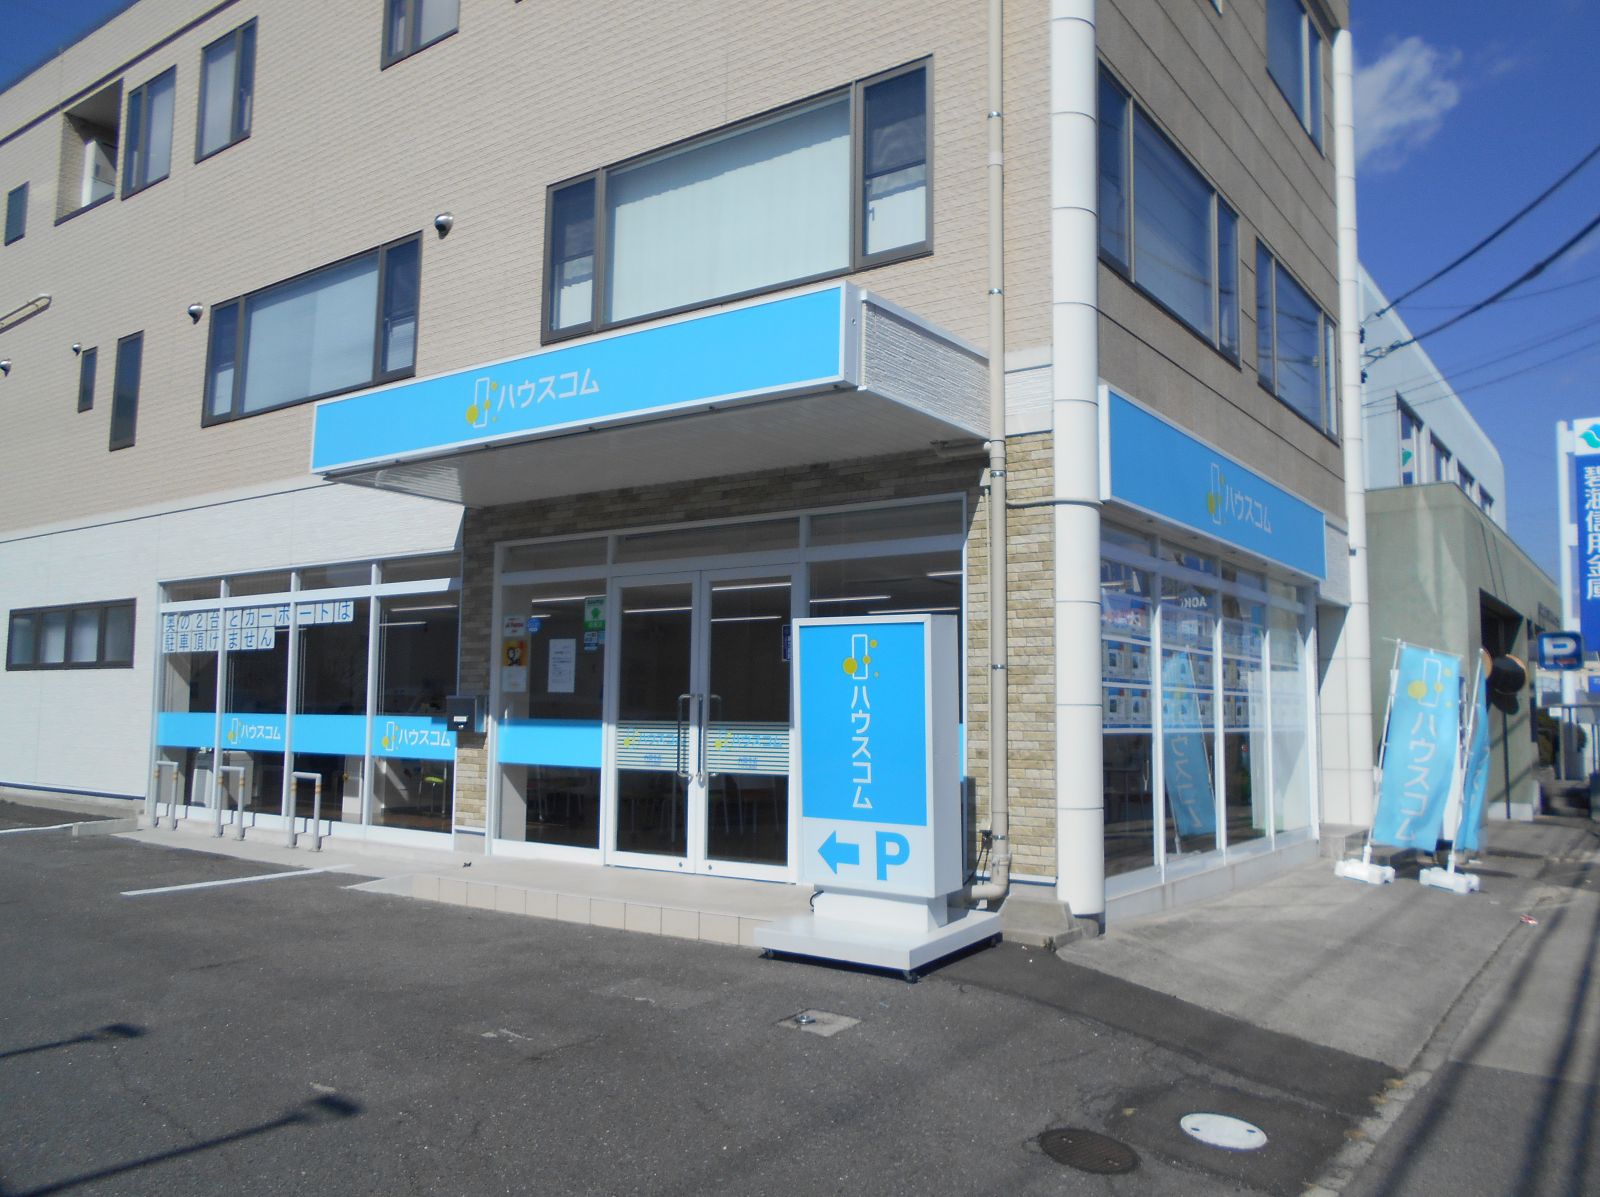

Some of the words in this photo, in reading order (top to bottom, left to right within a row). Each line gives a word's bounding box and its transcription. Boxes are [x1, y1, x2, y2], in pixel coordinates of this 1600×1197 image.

[497, 367, 600, 412] ハウスコム
[1225, 484, 1273, 534] ハウスコム
[241, 724, 281, 740] ハウスコム
[398, 728, 451, 747] ハウスコム
[850, 685, 873, 809] ハウスコム
[1394, 711, 1437, 841] ハウスコム
[875, 831, 910, 881] P
